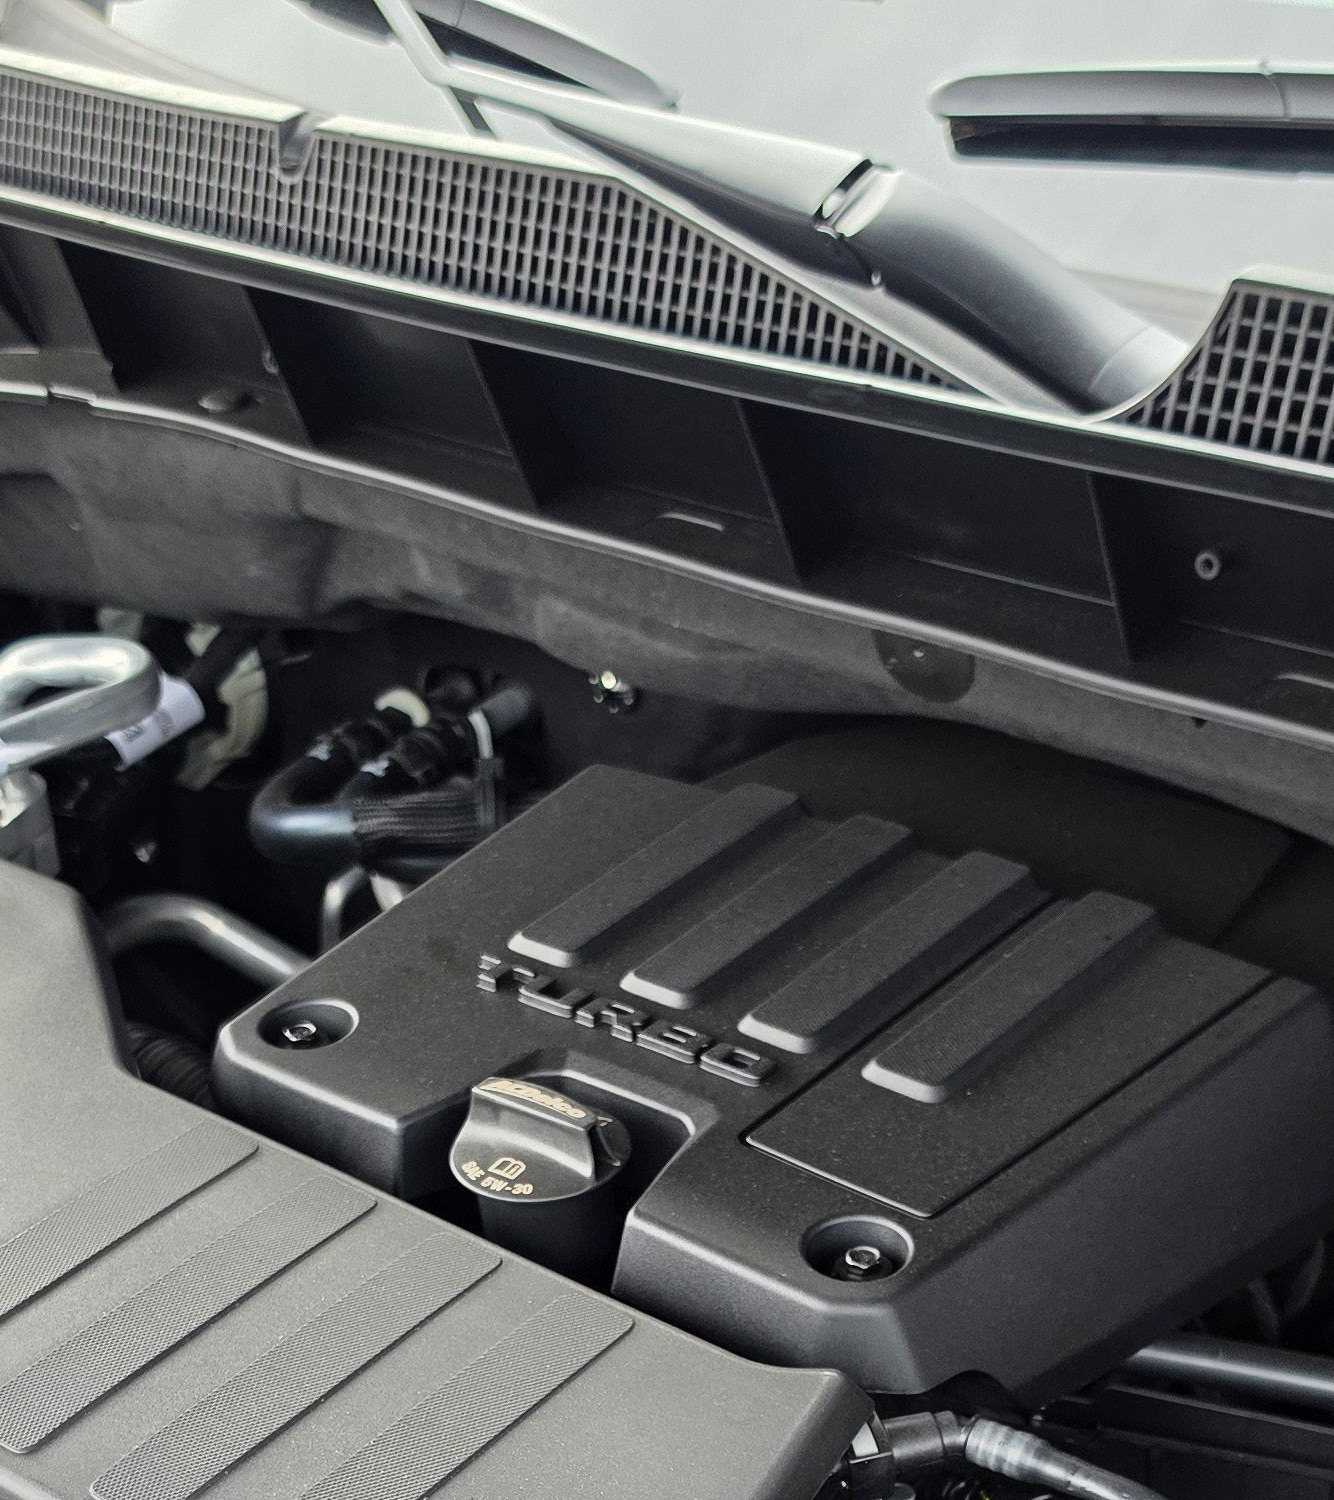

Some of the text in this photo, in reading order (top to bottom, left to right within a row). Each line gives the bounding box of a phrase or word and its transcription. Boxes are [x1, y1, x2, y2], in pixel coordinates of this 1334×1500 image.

[476, 954, 781, 1088] TURBO
[479, 1080, 586, 1119] ACDelco
[480, 1176, 534, 1196] 5W-30
